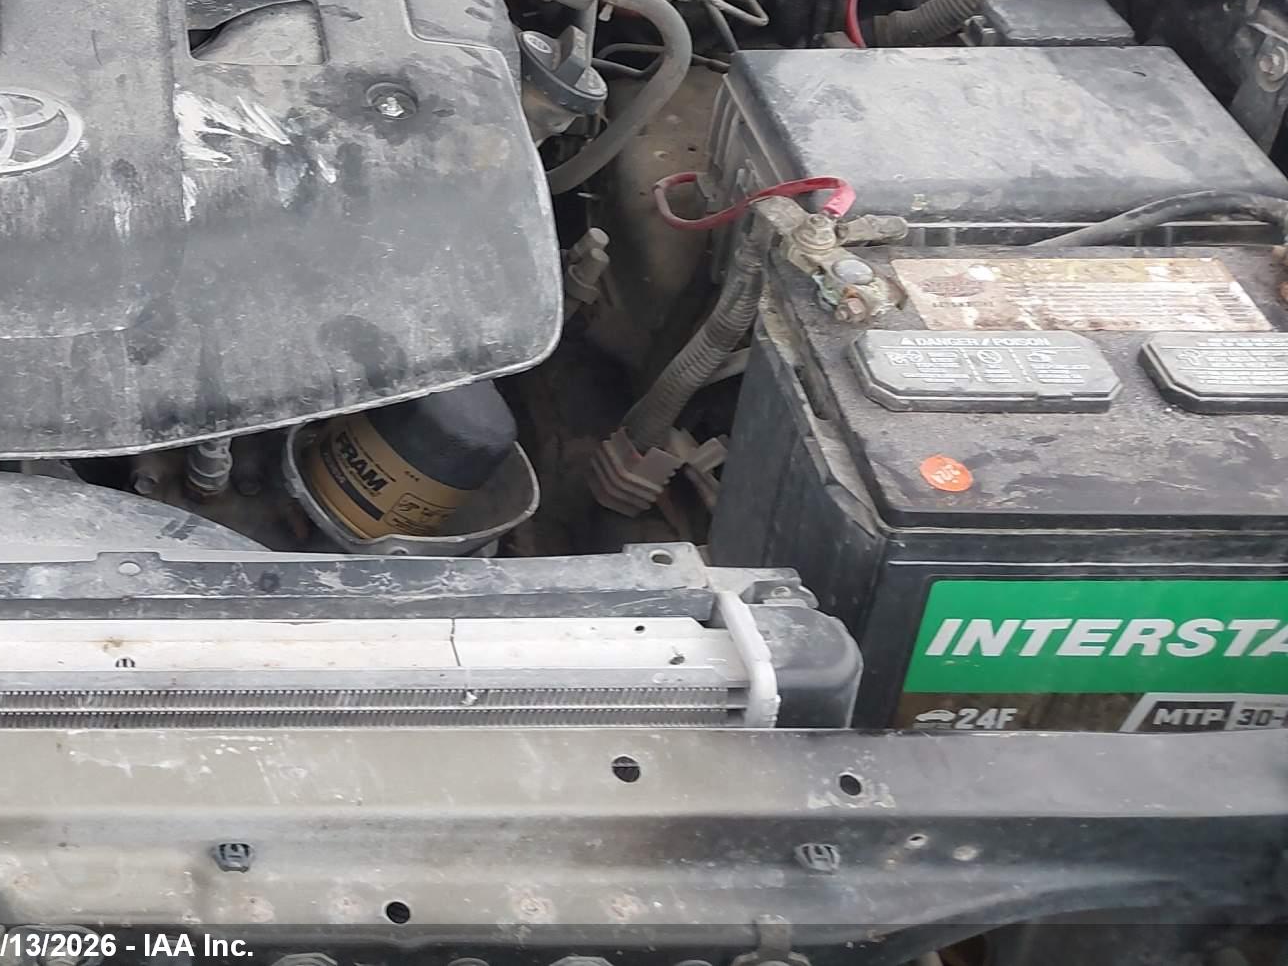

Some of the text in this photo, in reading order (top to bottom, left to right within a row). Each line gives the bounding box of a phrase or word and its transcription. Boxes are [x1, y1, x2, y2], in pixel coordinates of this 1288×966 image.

[335, 430, 389, 492] FRAM
[954, 707, 1018, 730] 24F
[1152, 708, 1288, 728] MTP 30-
